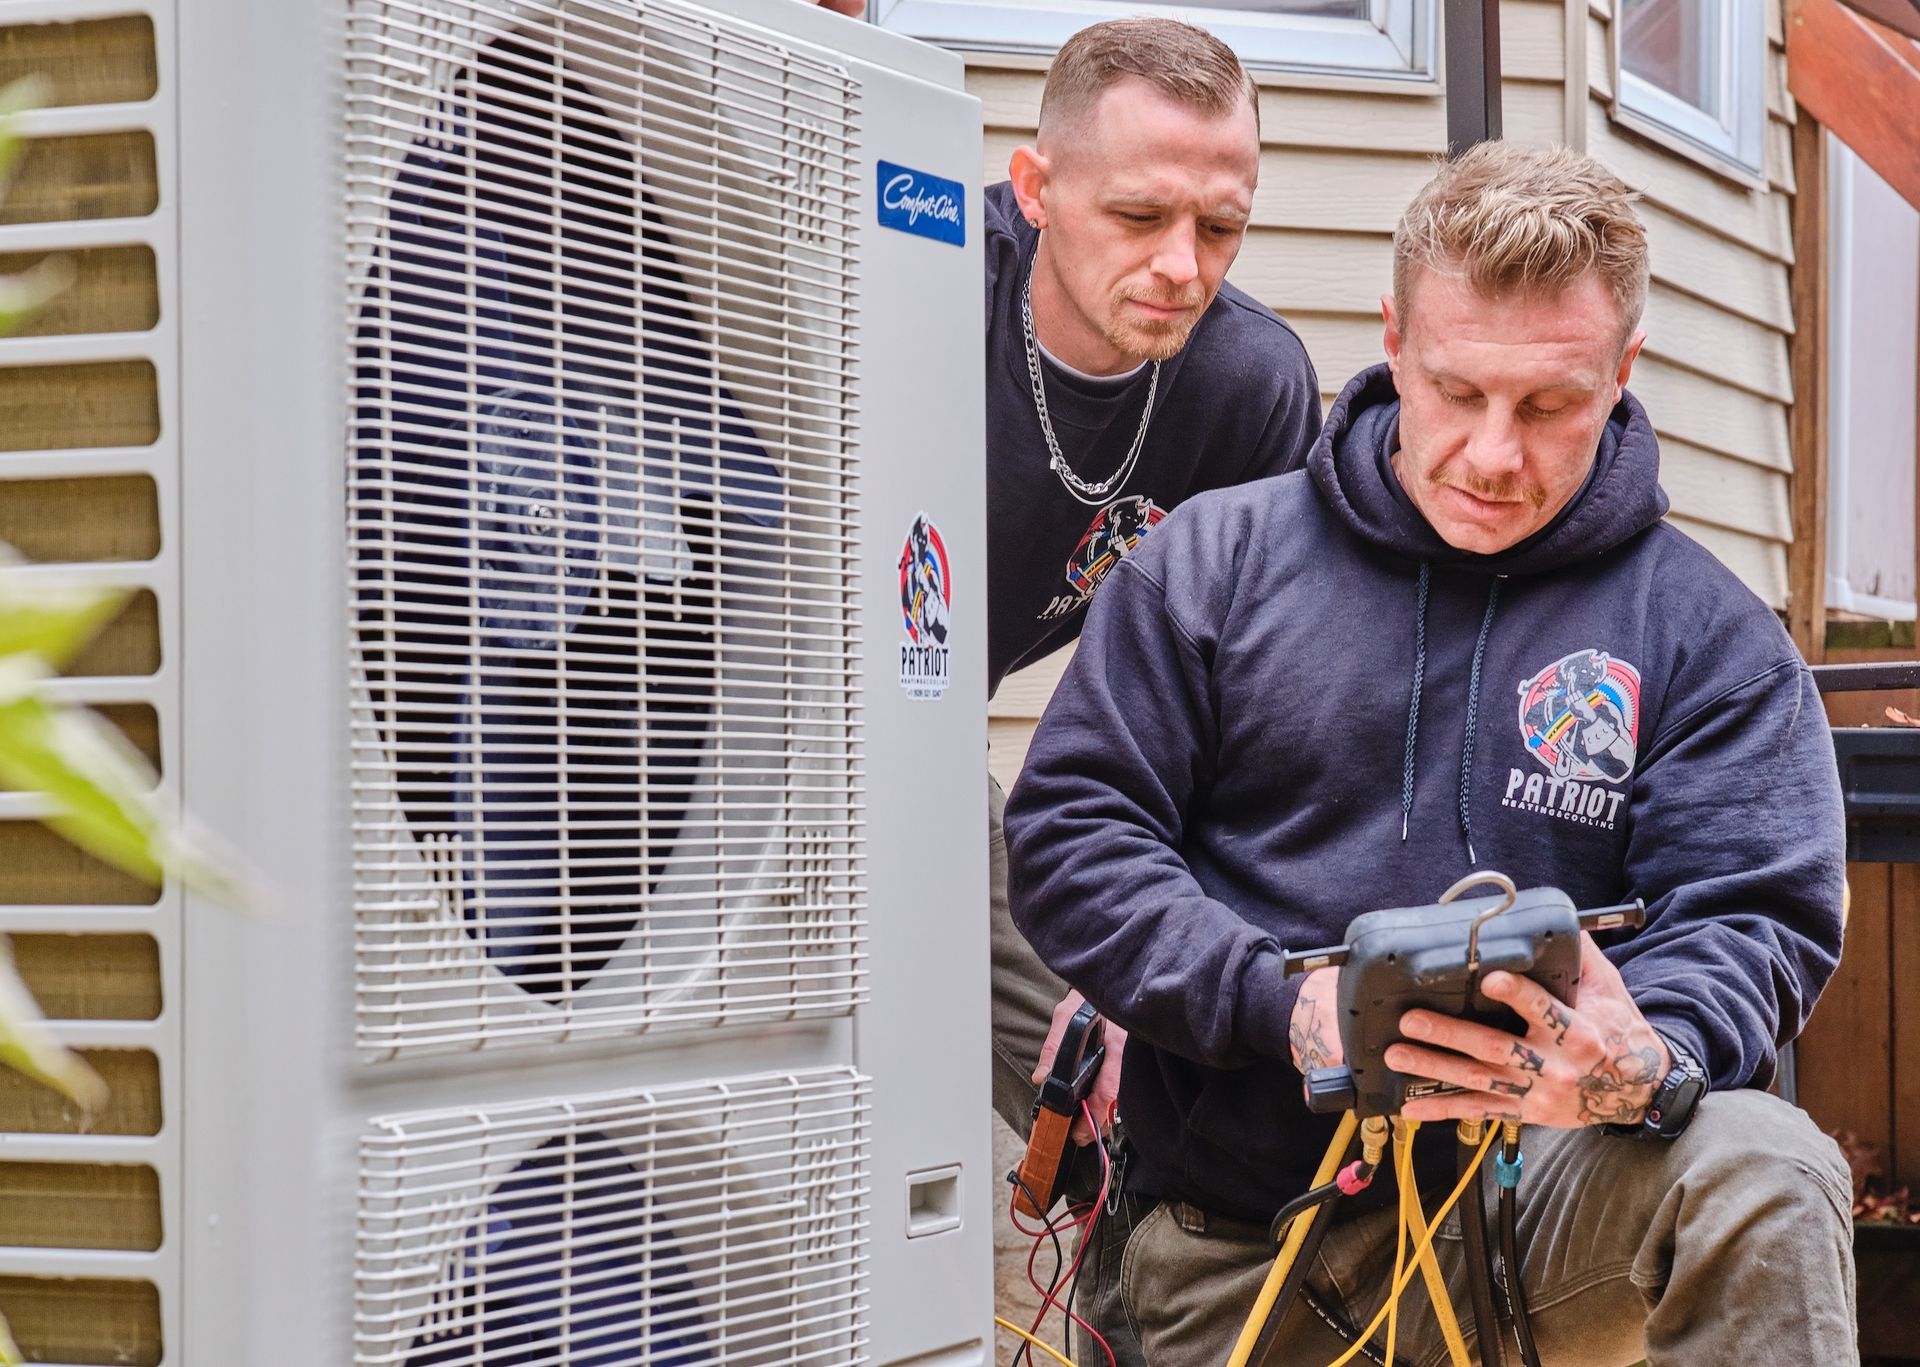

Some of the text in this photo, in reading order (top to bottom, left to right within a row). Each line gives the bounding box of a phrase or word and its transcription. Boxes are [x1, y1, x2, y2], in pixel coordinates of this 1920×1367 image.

[901, 646, 948, 677] PATRIOT
[1505, 768, 1626, 822] PATRIOT
[1501, 798, 1615, 830] HEATING&COOLING
